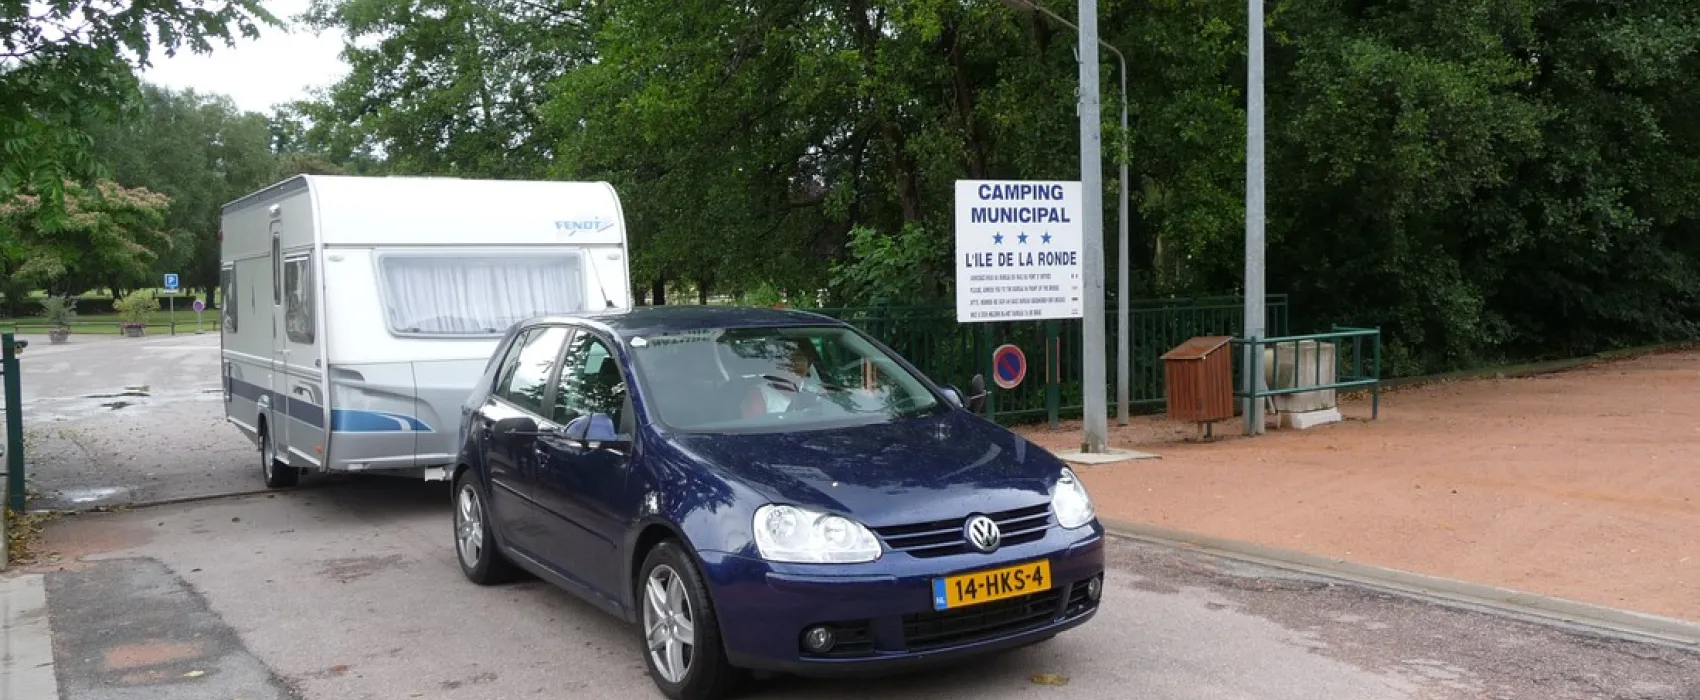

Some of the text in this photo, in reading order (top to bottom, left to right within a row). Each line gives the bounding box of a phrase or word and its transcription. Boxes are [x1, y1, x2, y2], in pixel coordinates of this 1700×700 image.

[978, 184, 1064, 200] CAMPING
[971, 207, 1070, 223] MUNICIPAL
[555, 221, 602, 230] FENDT
[965, 251, 1077, 268] L'ILE DE LA RONDE
[954, 565, 1043, 601] 14-HKS-4
[936, 596, 945, 604] NL
